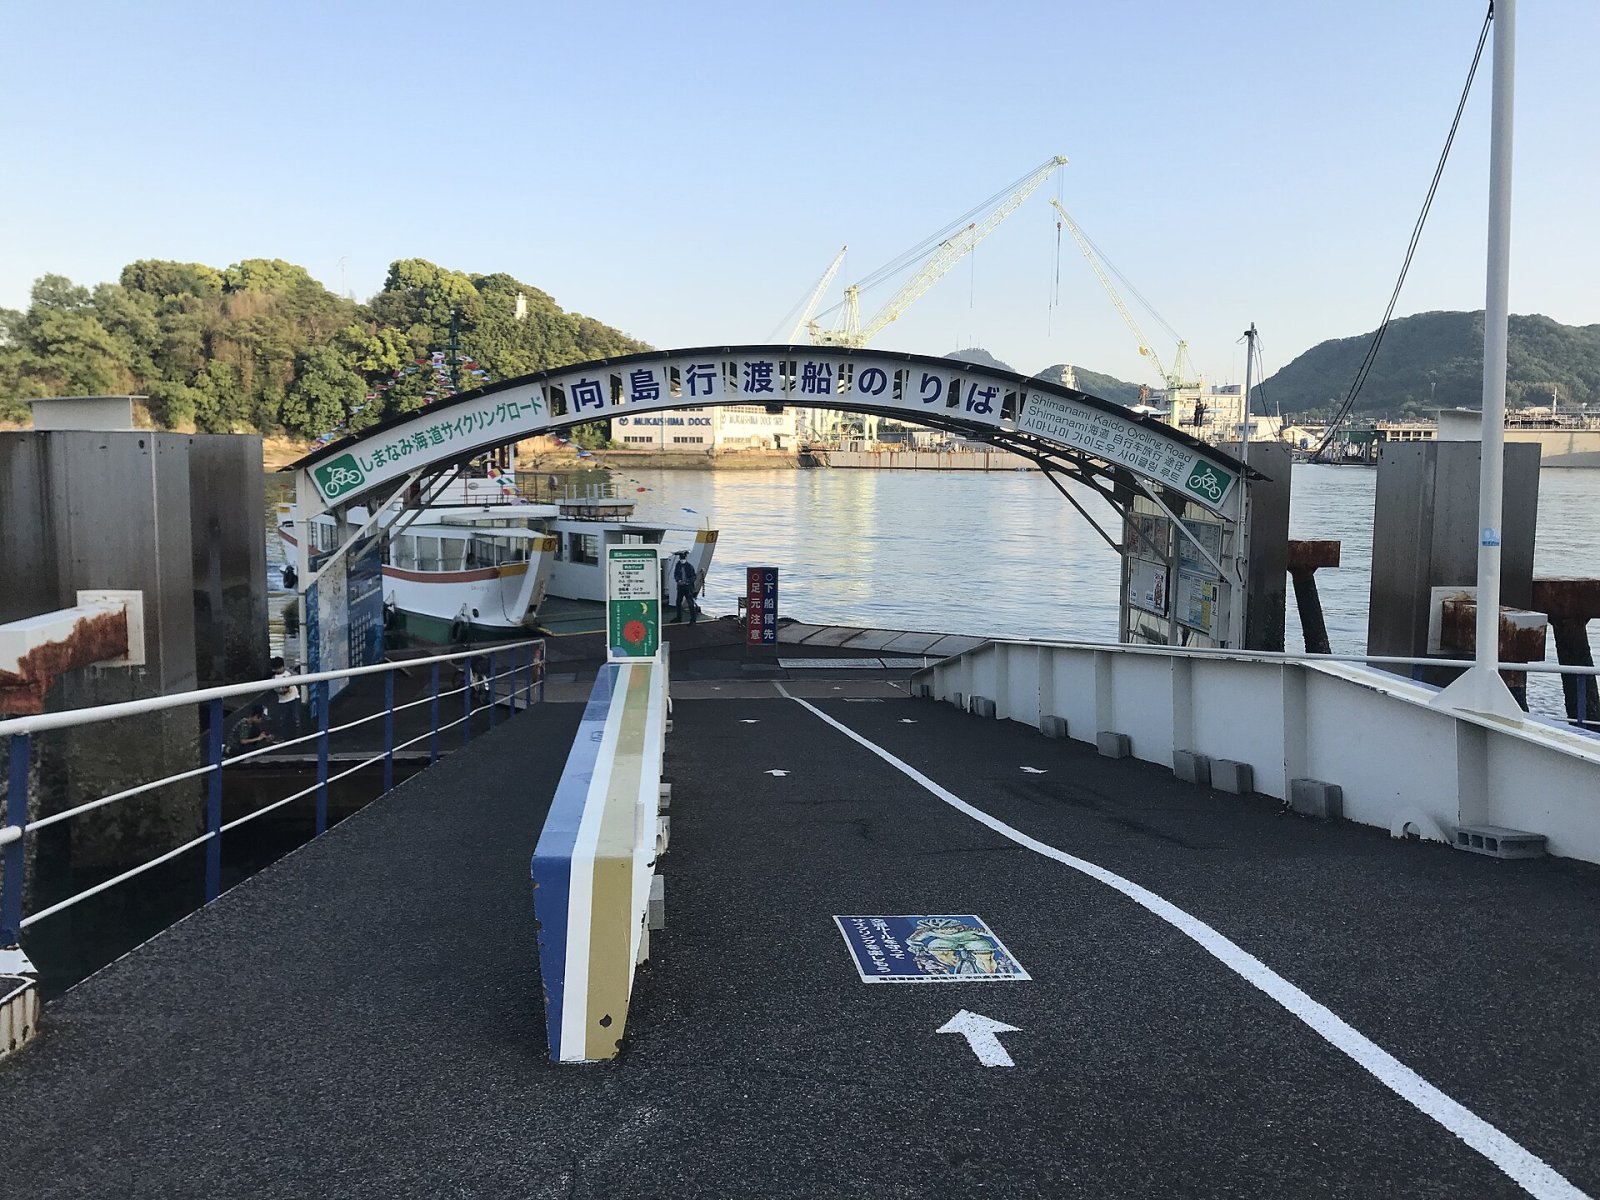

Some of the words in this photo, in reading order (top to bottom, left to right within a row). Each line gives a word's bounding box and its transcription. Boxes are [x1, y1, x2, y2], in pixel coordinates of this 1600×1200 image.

[570, 360, 1000, 415] 向島行渡船のりば
[359, 396, 543, 473] しまなみ海道サイクリングロード
[633, 417, 685, 426] MUKAISHIMA
[688, 417, 712, 426] DOCK
[1024, 417, 1069, 439] 시마나미
[1031, 394, 1091, 421] Shimanami
[1094, 415, 1125, 433] Kaido
[1127, 427, 1162, 451] Cycling
[1164, 444, 1193, 463] Road
[750, 582, 761, 640] 足元注意
[763, 582, 775, 640] 下船優先
